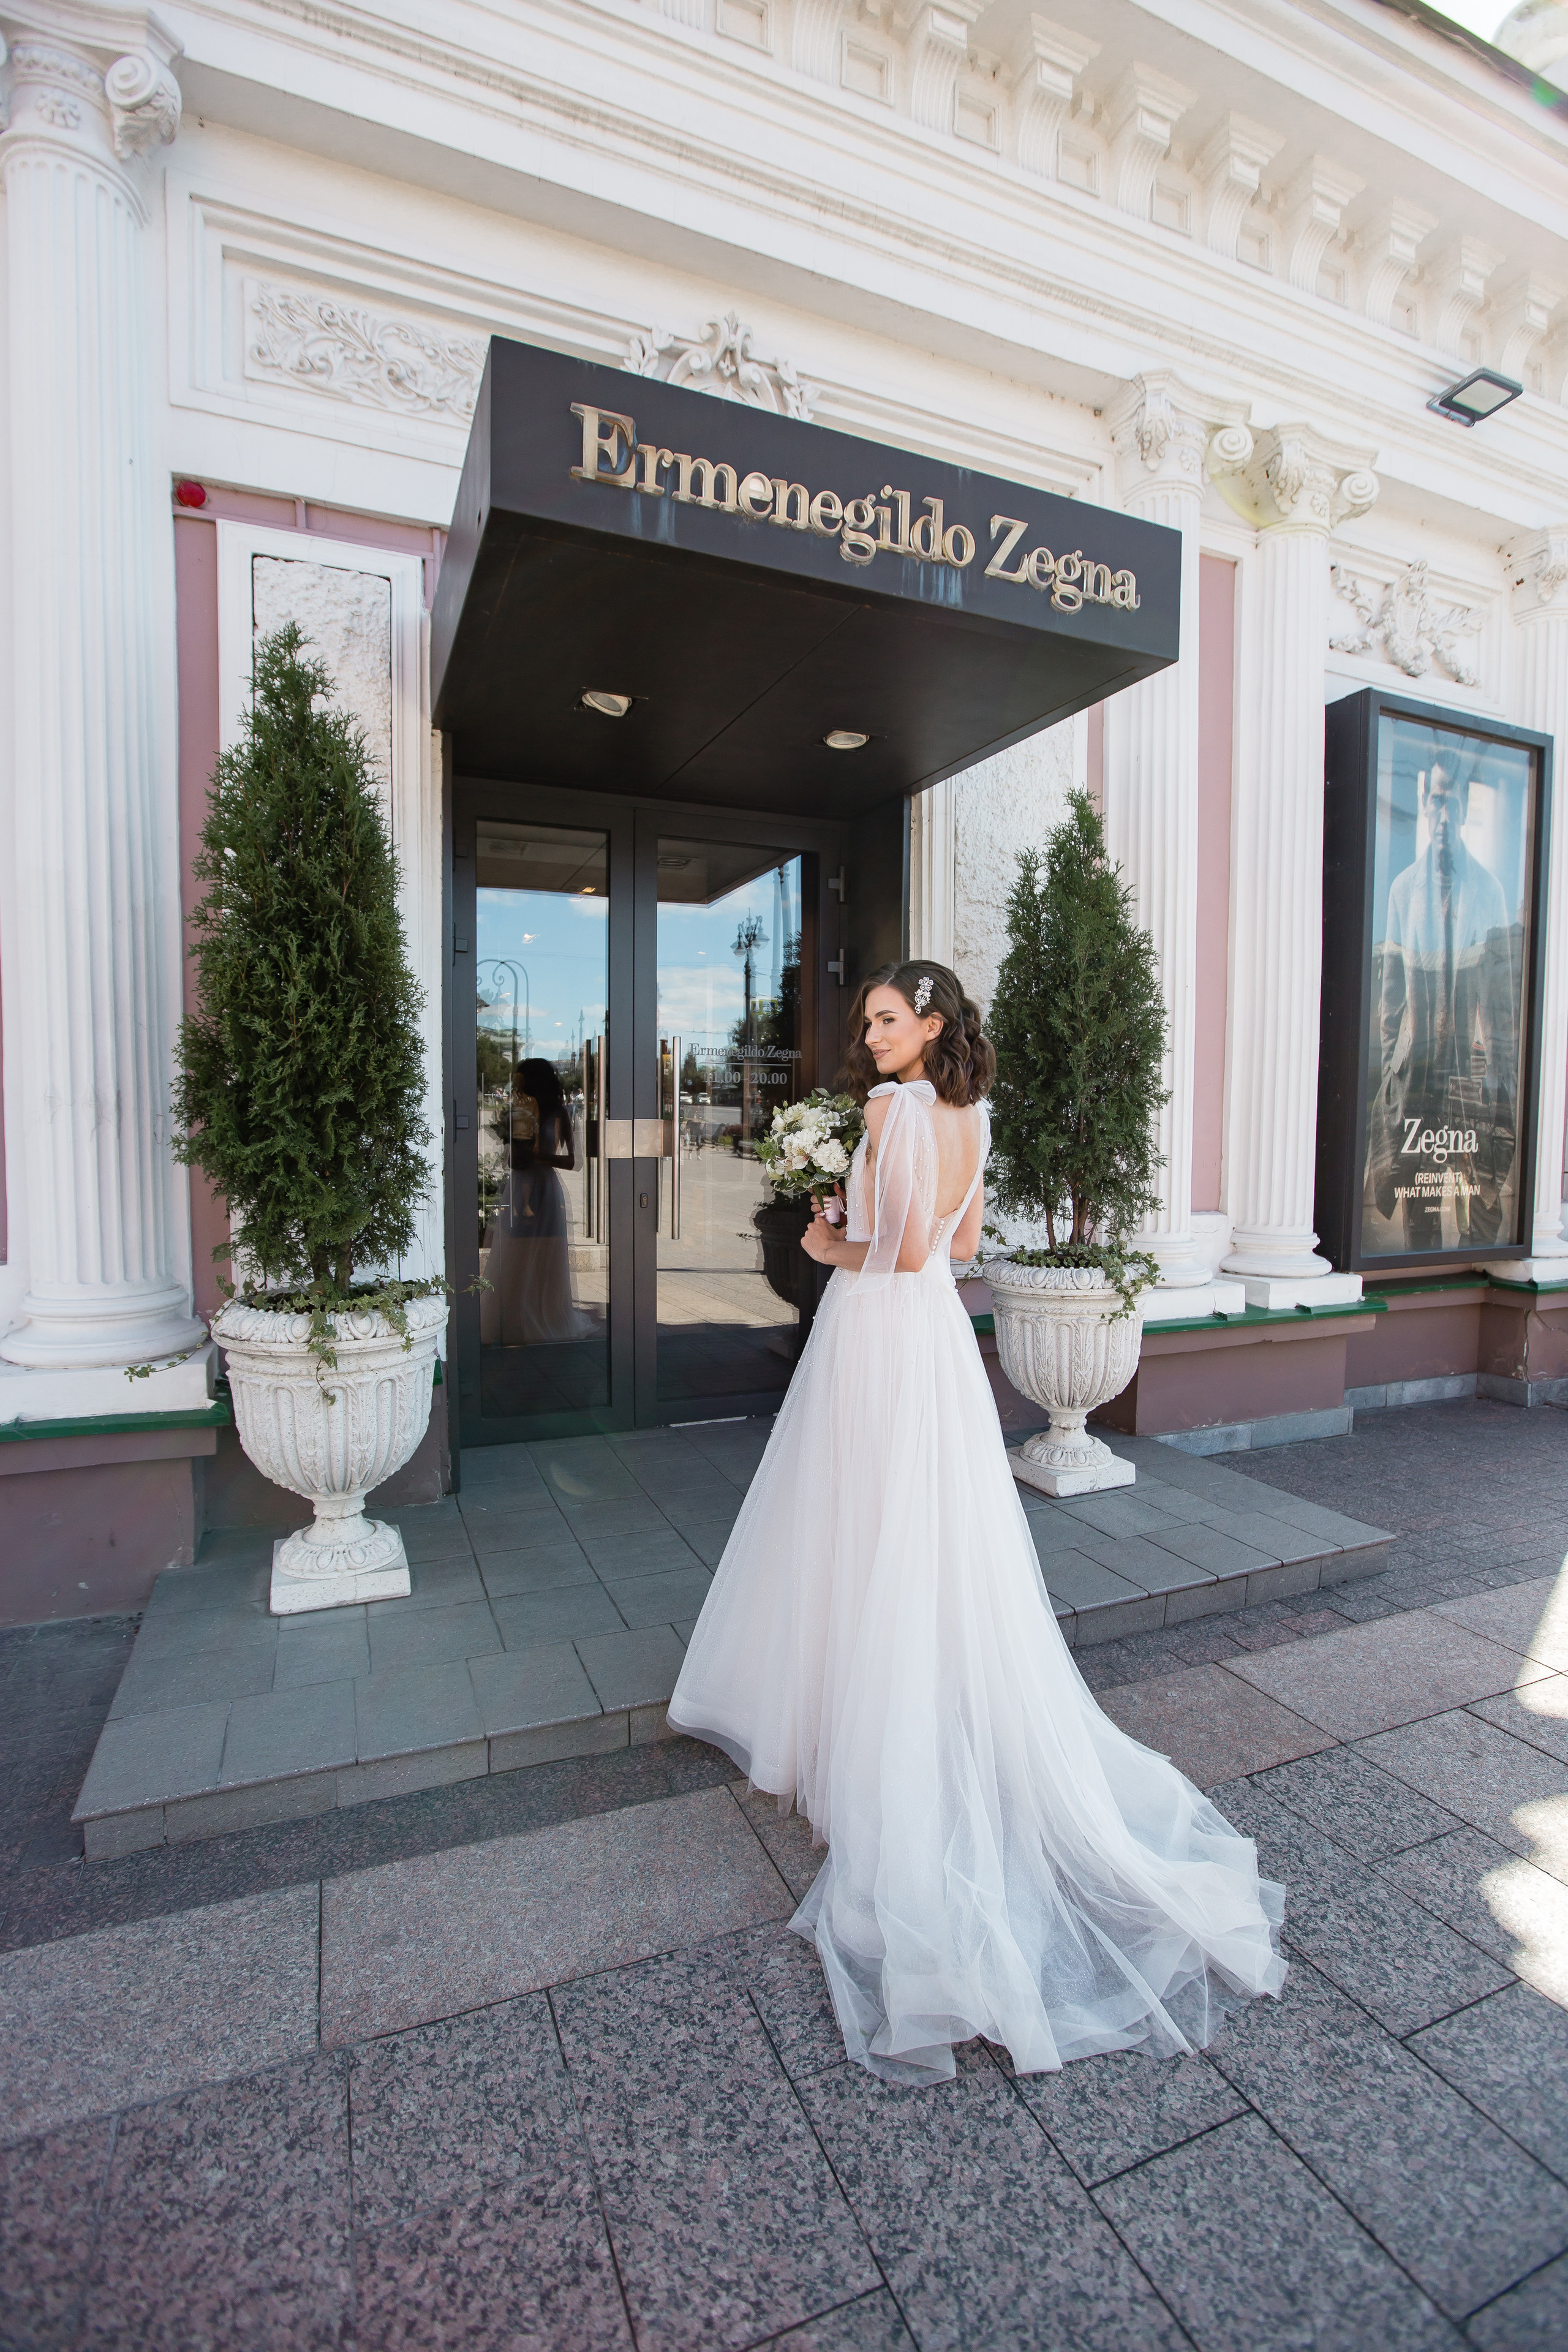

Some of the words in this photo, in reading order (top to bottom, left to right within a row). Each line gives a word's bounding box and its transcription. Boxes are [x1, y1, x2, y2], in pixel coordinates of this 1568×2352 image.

[570, 402, 976, 567] Ermenegildo
[984, 513, 1141, 614] Zegna
[688, 1042, 765, 1060] Ermenegildo
[766, 1045, 802, 1061] Zegna
[1401, 1118, 1479, 1164] Zegna
[1414, 1171, 1463, 1185] (REINVENT)
[1394, 1186, 1421, 1198] WHAT
[1422, 1186, 1452, 1197] MAKES
[1453, 1185, 1460, 1196] A
[1461, 1185, 1480, 1196] MAN
